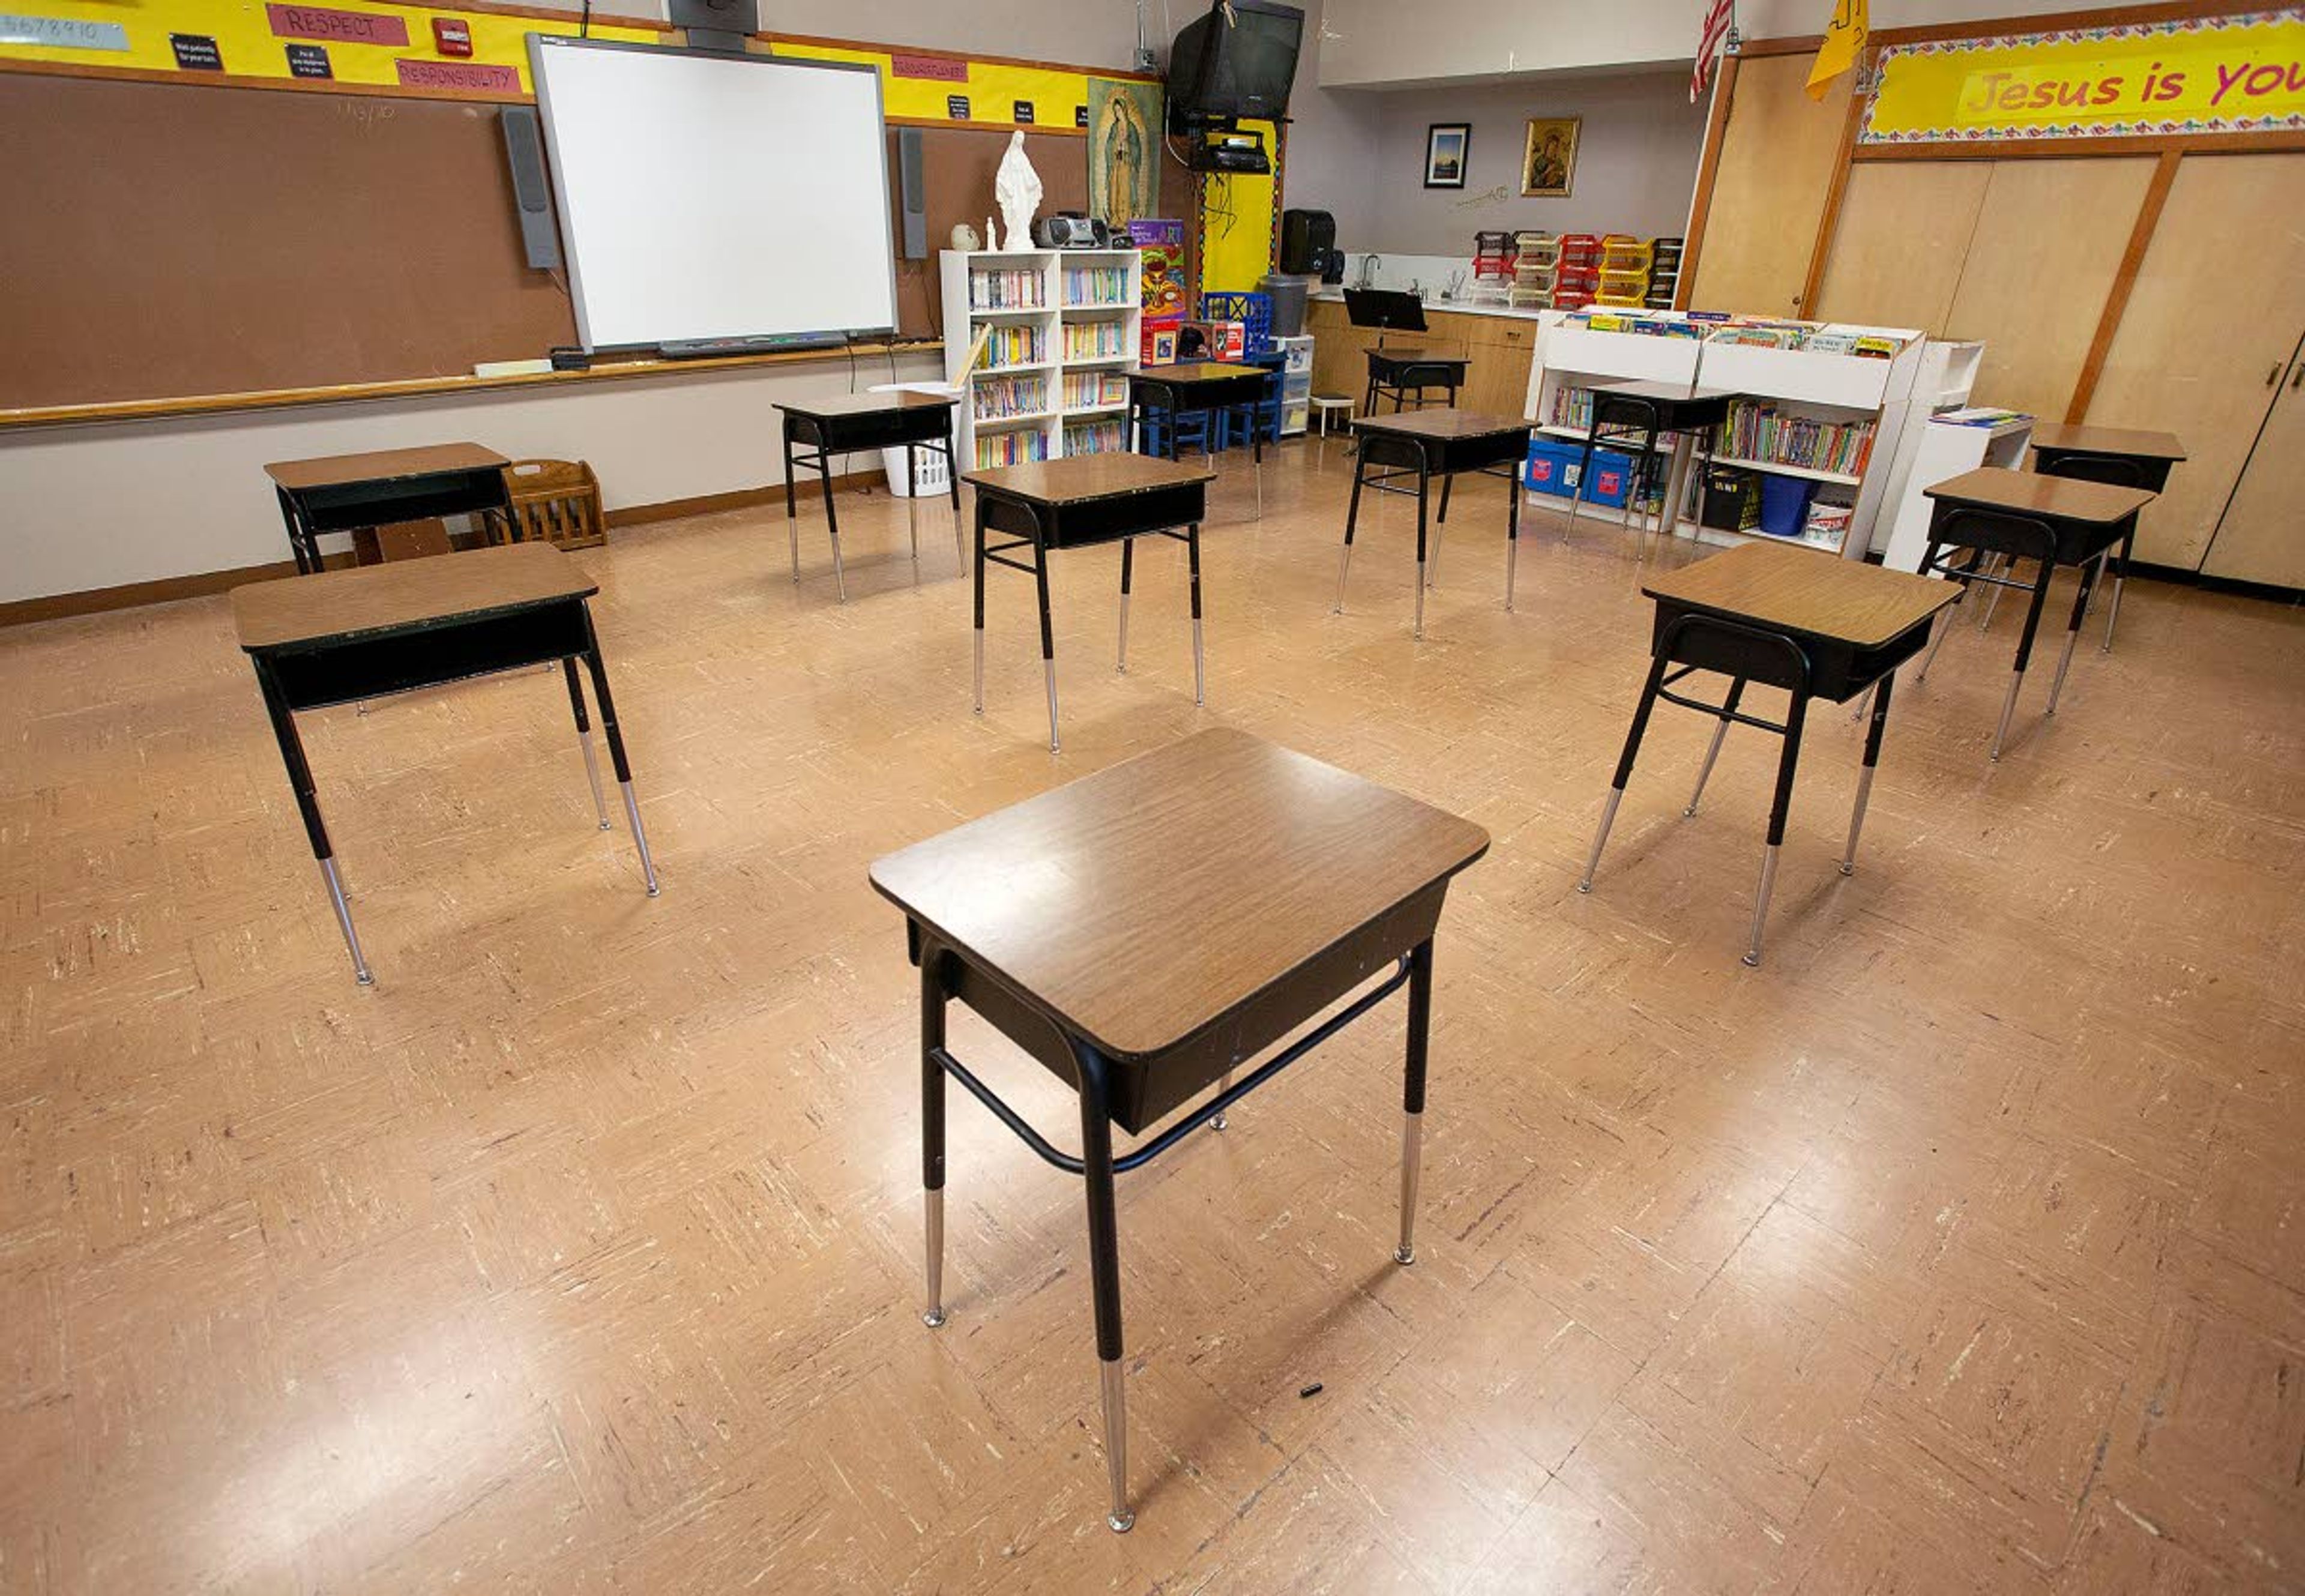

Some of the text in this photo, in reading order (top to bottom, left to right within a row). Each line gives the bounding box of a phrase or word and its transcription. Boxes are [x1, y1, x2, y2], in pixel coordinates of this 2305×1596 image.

[286, 9, 374, 37] RESPECT
[399, 65, 510, 88] RESPONSIBILITY
[1966, 73, 2124, 112] Jesus
[2141, 62, 2186, 103] is
